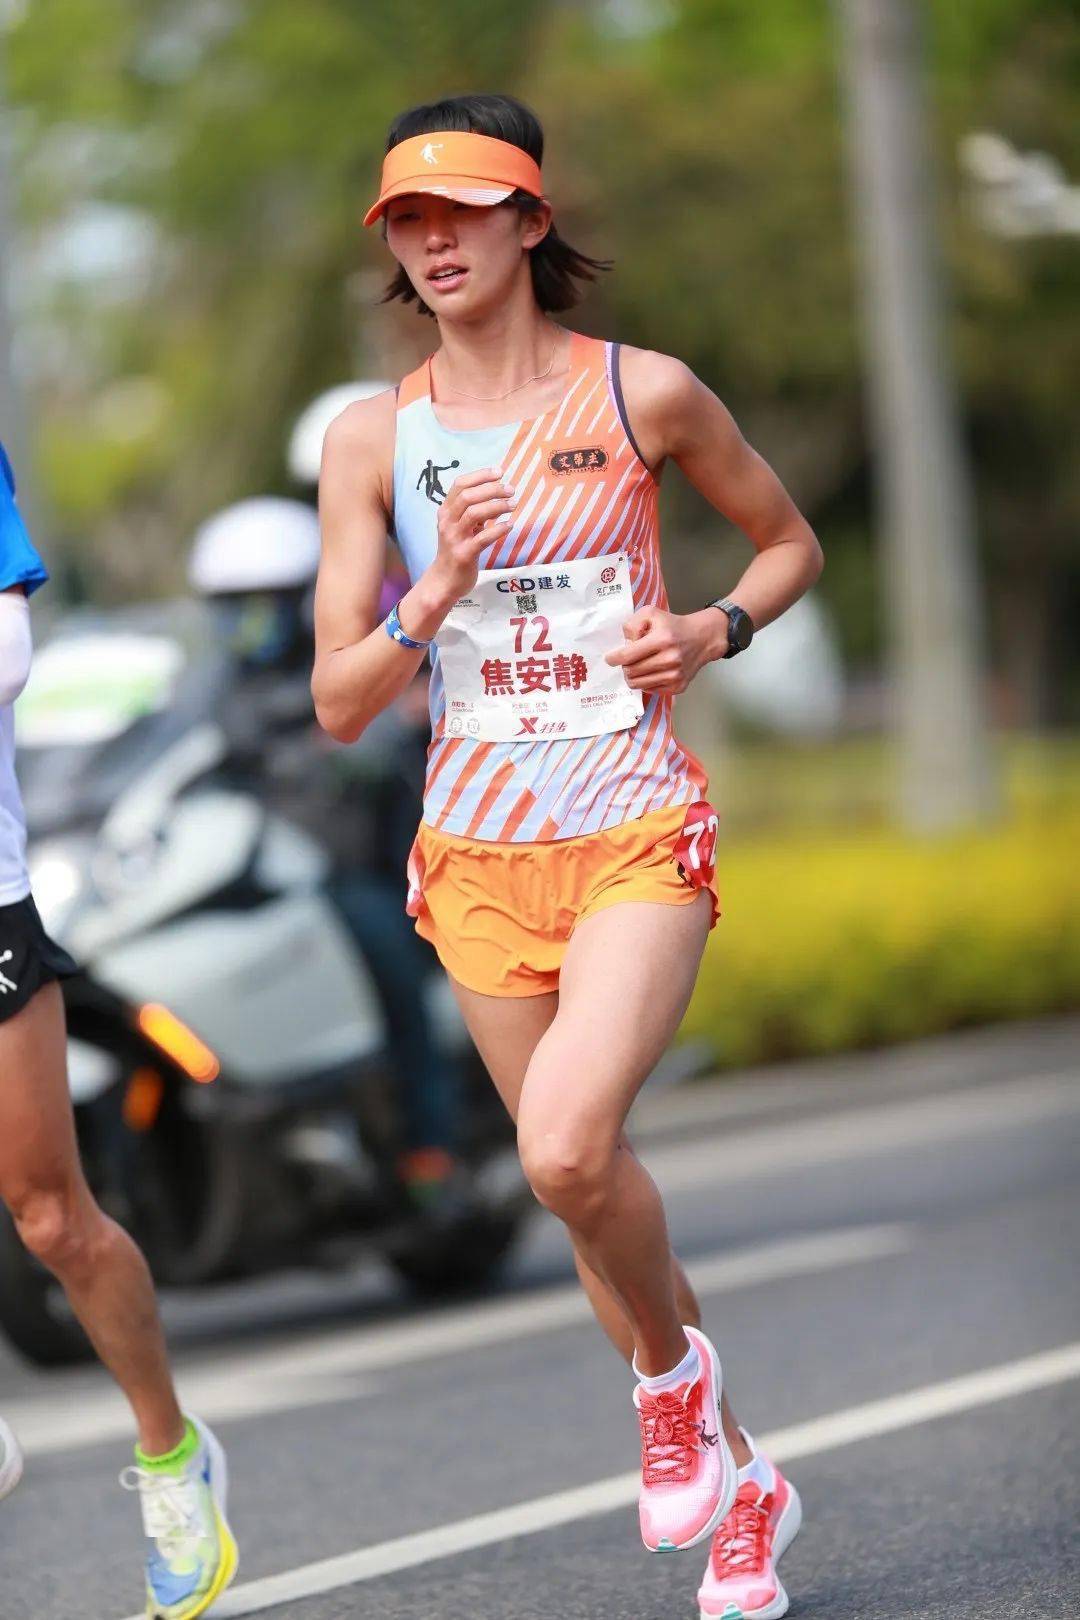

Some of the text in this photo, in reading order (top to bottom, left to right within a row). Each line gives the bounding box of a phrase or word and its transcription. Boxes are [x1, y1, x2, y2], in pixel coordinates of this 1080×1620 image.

[496, 574, 571, 593] C&D 建发
[509, 615, 553, 654] 72
[480, 653, 588, 697] 焦安静
